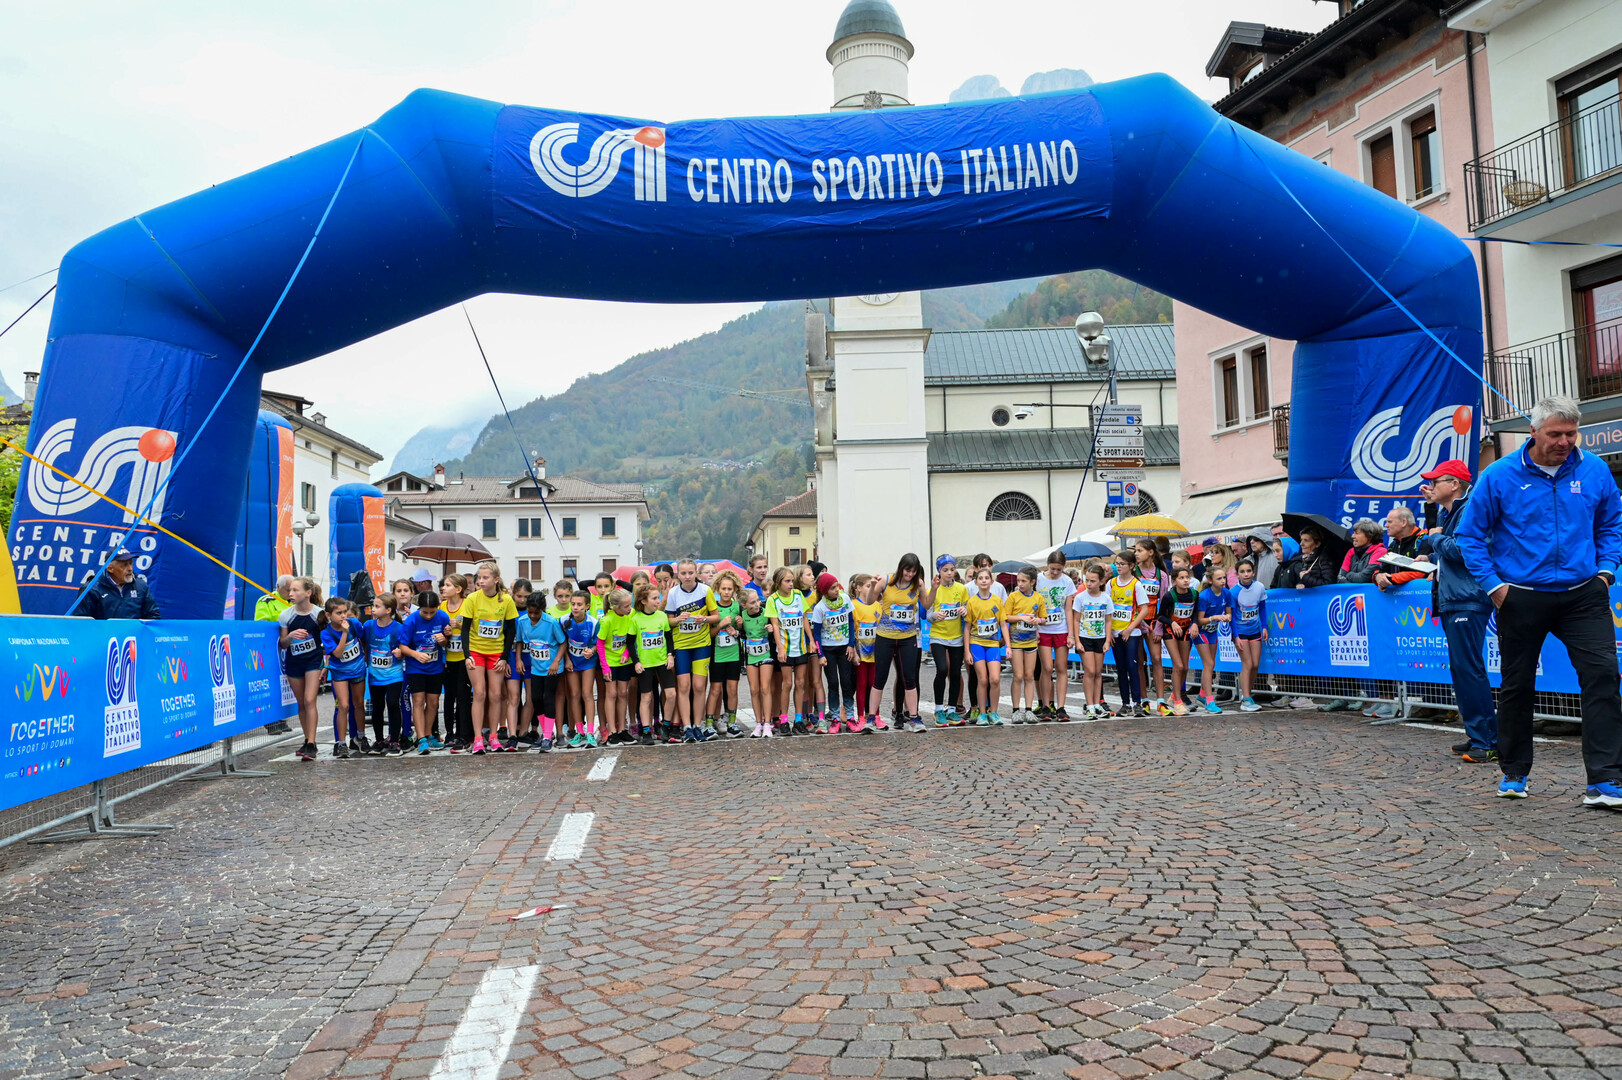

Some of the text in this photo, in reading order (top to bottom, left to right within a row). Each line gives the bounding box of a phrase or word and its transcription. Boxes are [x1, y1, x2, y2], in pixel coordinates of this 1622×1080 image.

[686, 139, 1079, 203] CENTRO SPORTIVO ITALIANO
[1103, 448, 1144, 456] SPORT AGORDO
[896, 611, 907, 619] 39
[1088, 610, 1102, 619] 213
[1178, 608, 1192, 617] 147
[1245, 609, 1259, 619] 204
[786, 618, 800, 627] 361
[830, 615, 845, 625] 210
[482, 626, 499, 636] 257
[683, 622, 697, 631] 367
[984, 624, 995, 633] 44
[864, 628, 874, 637] 61
[646, 637, 662, 647] 346
[724, 635, 731, 644] 5
[1396, 636, 1449, 648] TOGETHER
[294, 641, 311, 653] 458
[752, 645, 763, 654] 13
[343, 646, 359, 660] 310
[1331, 654, 1369, 662] ITALIANO
[371, 656, 389, 666] 306
[214, 688, 236, 701] CENTRO
[160, 693, 196, 713] TOGETHER
[214, 698, 236, 711] SPORTIVO
[105, 708, 139, 725] CENTRO
[214, 707, 236, 720] ITALIANO
[9, 714, 75, 742] TOGETHER
[105, 719, 140, 737] SPORTIVO
[105, 731, 140, 749] ITALIANO
[4, 737, 75, 758] LO SPORT DI DOMANI
